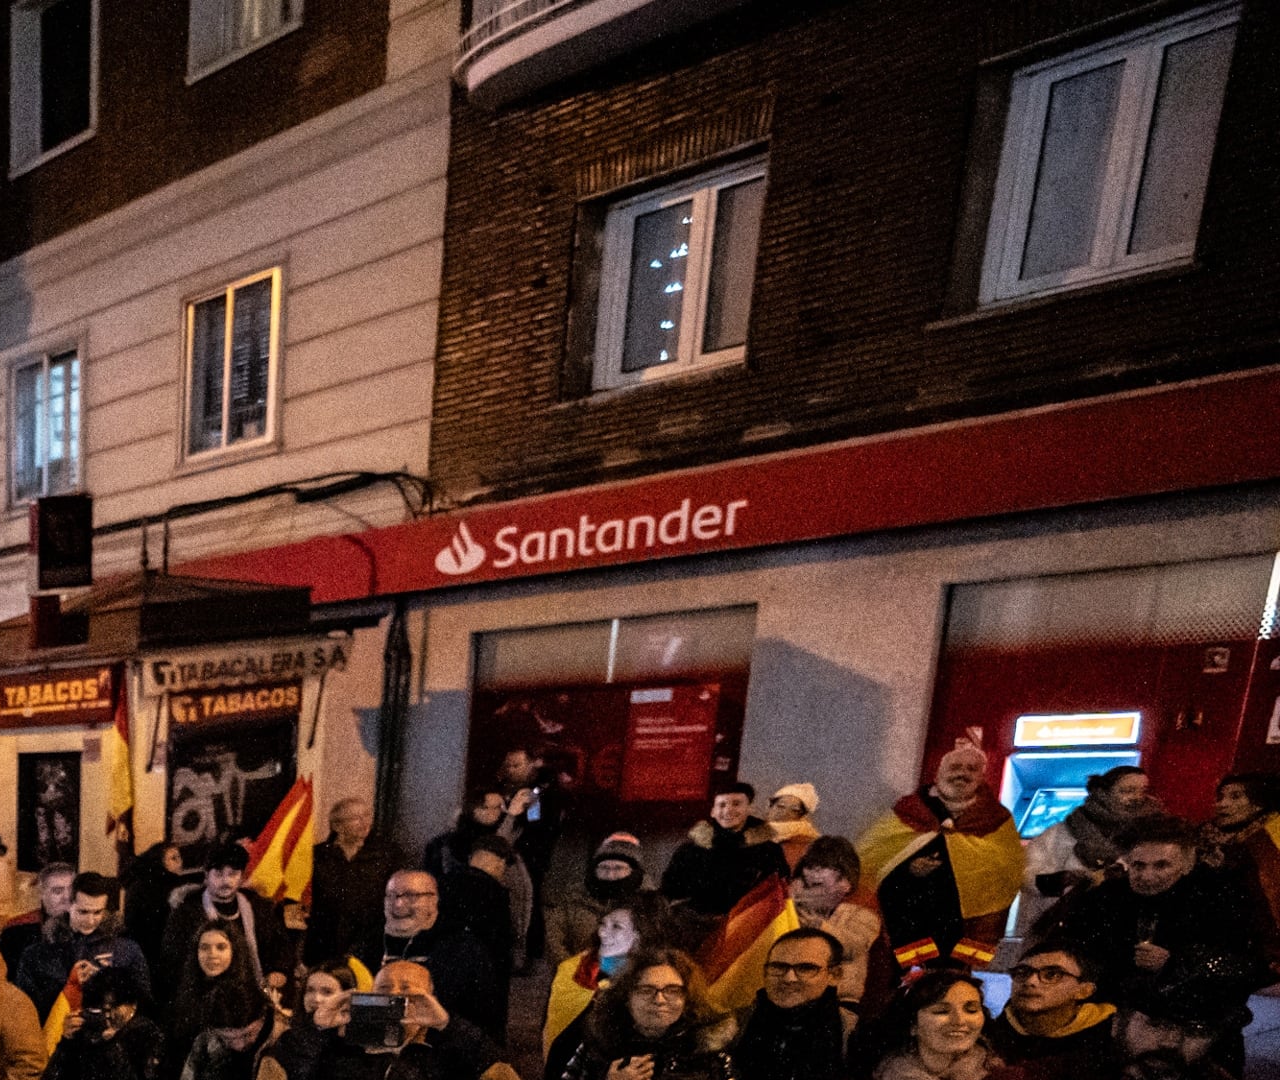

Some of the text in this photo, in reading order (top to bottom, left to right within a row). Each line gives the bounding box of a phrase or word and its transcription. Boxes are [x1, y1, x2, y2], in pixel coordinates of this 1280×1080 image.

[492, 498, 748, 568] Santander
[177, 651, 305, 682] TABACALERA
[4, 678, 99, 707] TABACOS
[201, 686, 300, 717] TABACOS
